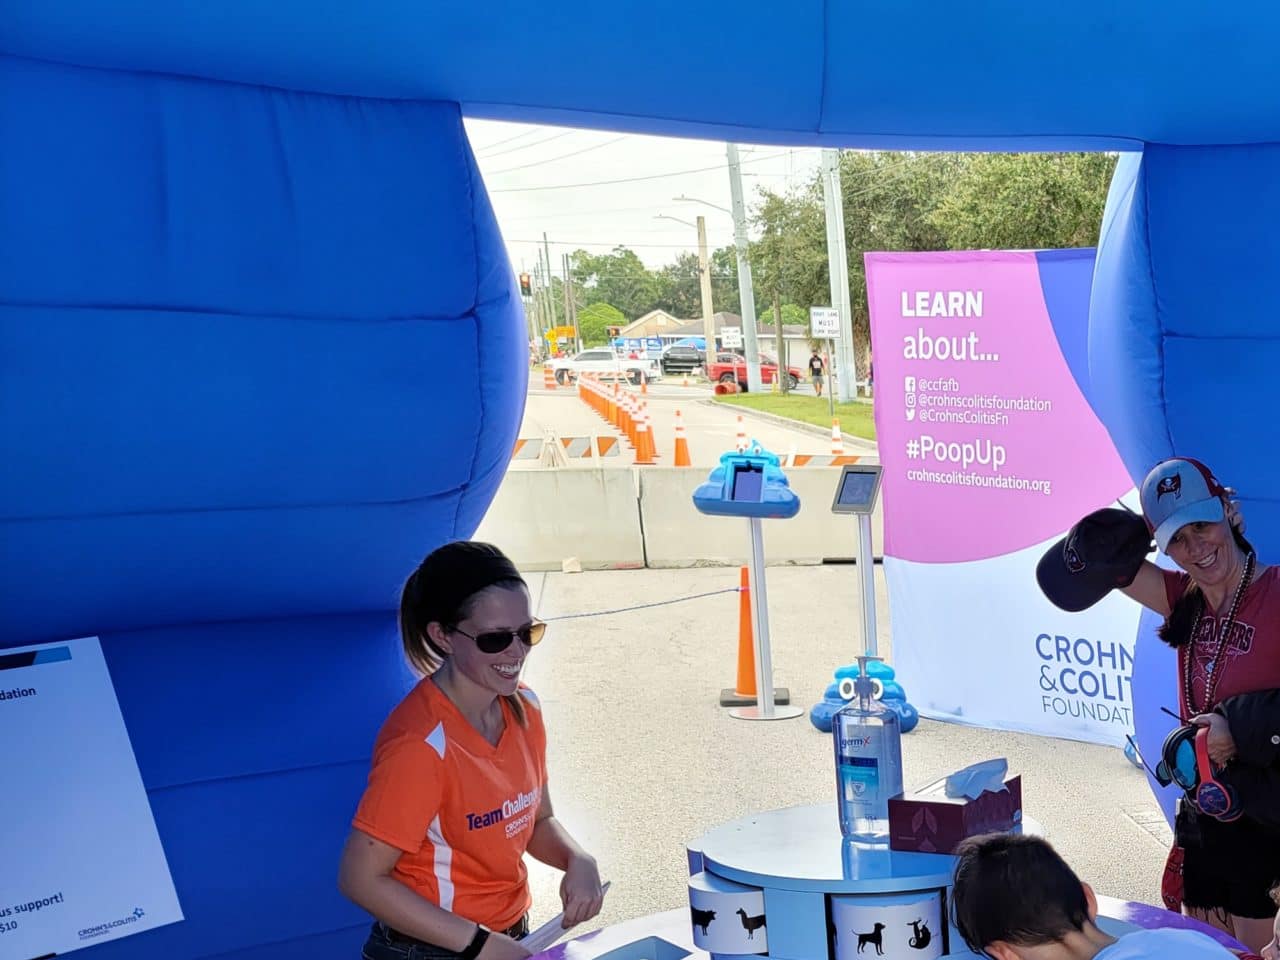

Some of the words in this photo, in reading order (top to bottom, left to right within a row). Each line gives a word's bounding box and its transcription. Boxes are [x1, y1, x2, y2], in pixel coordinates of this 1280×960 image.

[901, 290, 983, 317] LEARN
[903, 327, 999, 361] about...
[918, 377, 960, 393] @ccfafb
[918, 393, 1052, 412] @crohnscolitisfoundation
[919, 408, 1009, 425] @CrohnsColitisFn
[906, 435, 1006, 471] #PoopUp
[907, 467, 1051, 495] crohnscolitisfoundation.org
[1035, 633, 1134, 671] CROHN
[0, 687, 36, 700] dation
[1042, 695, 1131, 726] FOUNDAT
[14, 891, 64, 913] support!
